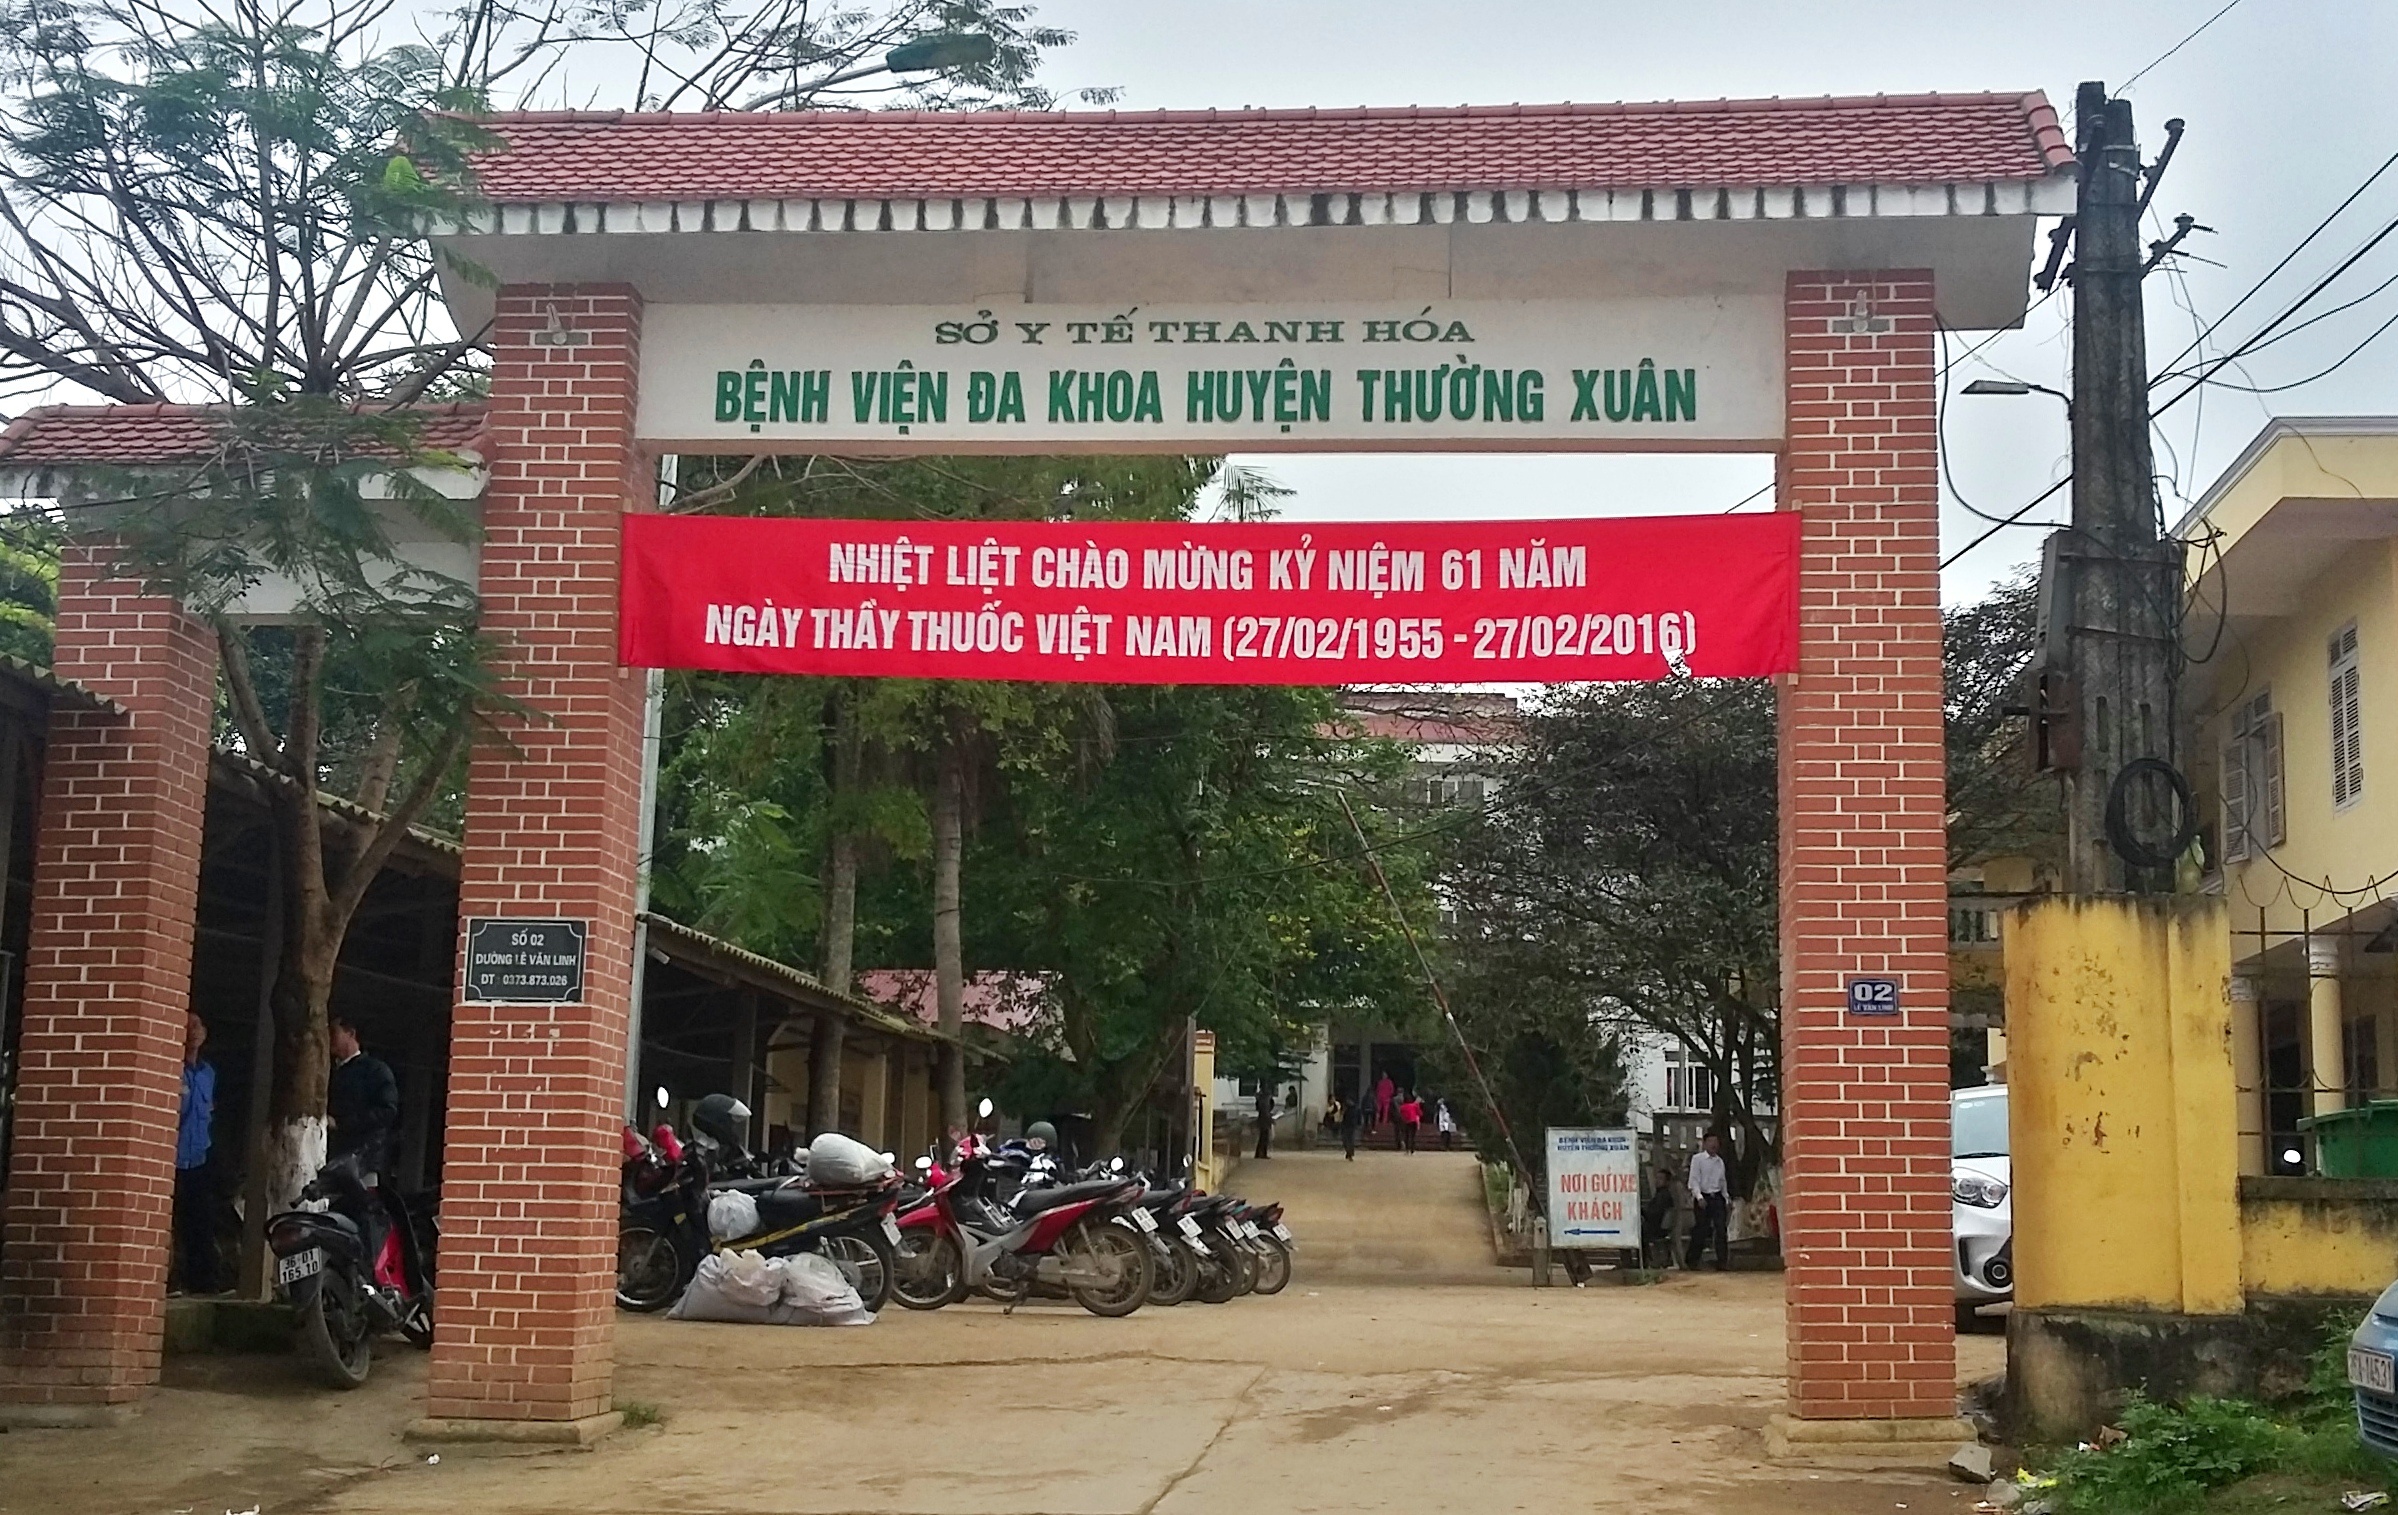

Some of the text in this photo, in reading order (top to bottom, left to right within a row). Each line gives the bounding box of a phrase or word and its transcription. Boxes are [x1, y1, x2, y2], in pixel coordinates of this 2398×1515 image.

[935, 306, 1476, 345] SỞ Y TẾ THANH HÓA
[714, 353, 1697, 434] BỆNH VIỆN ĐA KHOA HUYỆN THƯỜNG XUÂN
[828, 533, 1587, 599] NHIỆT LIỆT CHÀO MỪNG KỶ NIỆM 61 NĂM
[704, 597, 804, 648] NGÀY
[810, 598, 902, 651] THẦY
[907, 600, 1025, 653] THUỐC
[1036, 605, 1113, 661] VIỆT
[1125, 615, 1212, 657] NAM
[1222, 615, 1443, 662] (27/02/1955
[1473, 610, 1697, 658] 27/02/2016)
[511, 927, 545, 946] SỐ 02
[529, 952, 551, 966] VĂN
[553, 955, 577, 966] LINH
[1853, 983, 1893, 1001] 02
[1561, 1173, 1587, 1193] NƠI
[1619, 1174, 1638, 1193] XE
[1567, 1197, 1623, 1221] KHÁCH
